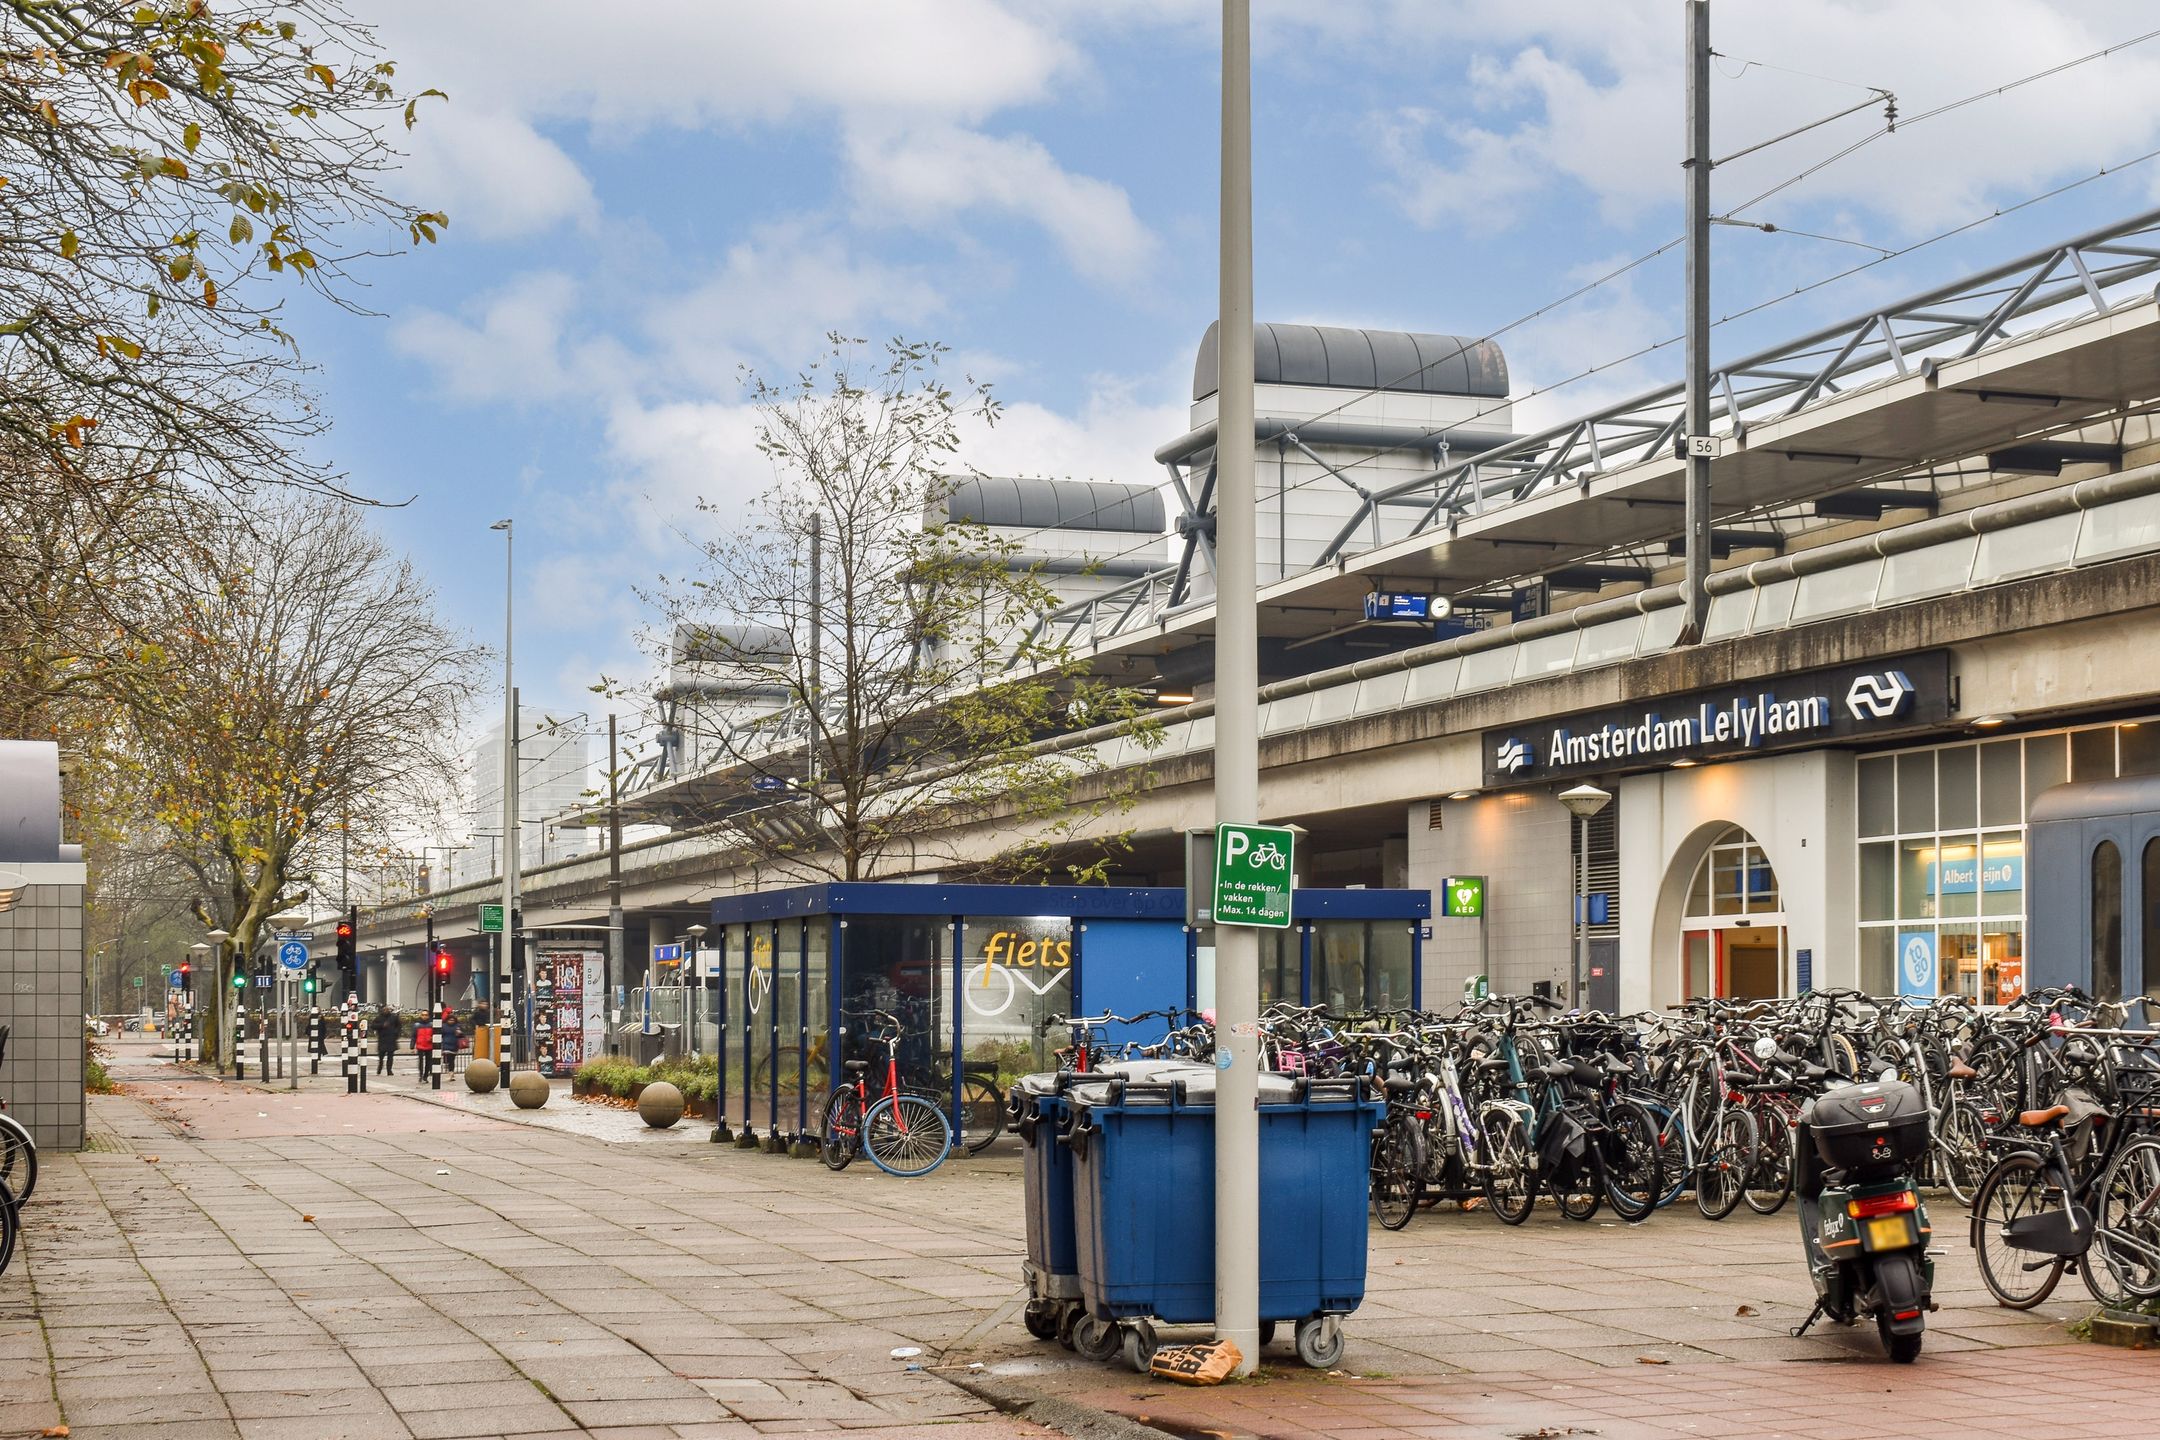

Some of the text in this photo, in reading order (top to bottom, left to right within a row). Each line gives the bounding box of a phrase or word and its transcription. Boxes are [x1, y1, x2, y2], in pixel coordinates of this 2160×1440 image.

[1696, 440, 1712, 453] 56
[1549, 693, 1824, 768] Amsterdam Lelylaan
[1225, 830, 1249, 866] P
[1944, 867, 2001, 885] Albert eijn
[1224, 880, 1281, 893] In de rekken/
[1223, 893, 1253, 903] vakken
[1222, 904, 1244, 915] Max.
[1246, 906, 1257, 915] 14
[1258, 907, 1284, 918] dagen
[982, 932, 1071, 988] fiets
[1909, 944, 1923, 963] to
[1914, 957, 1929, 982] go
